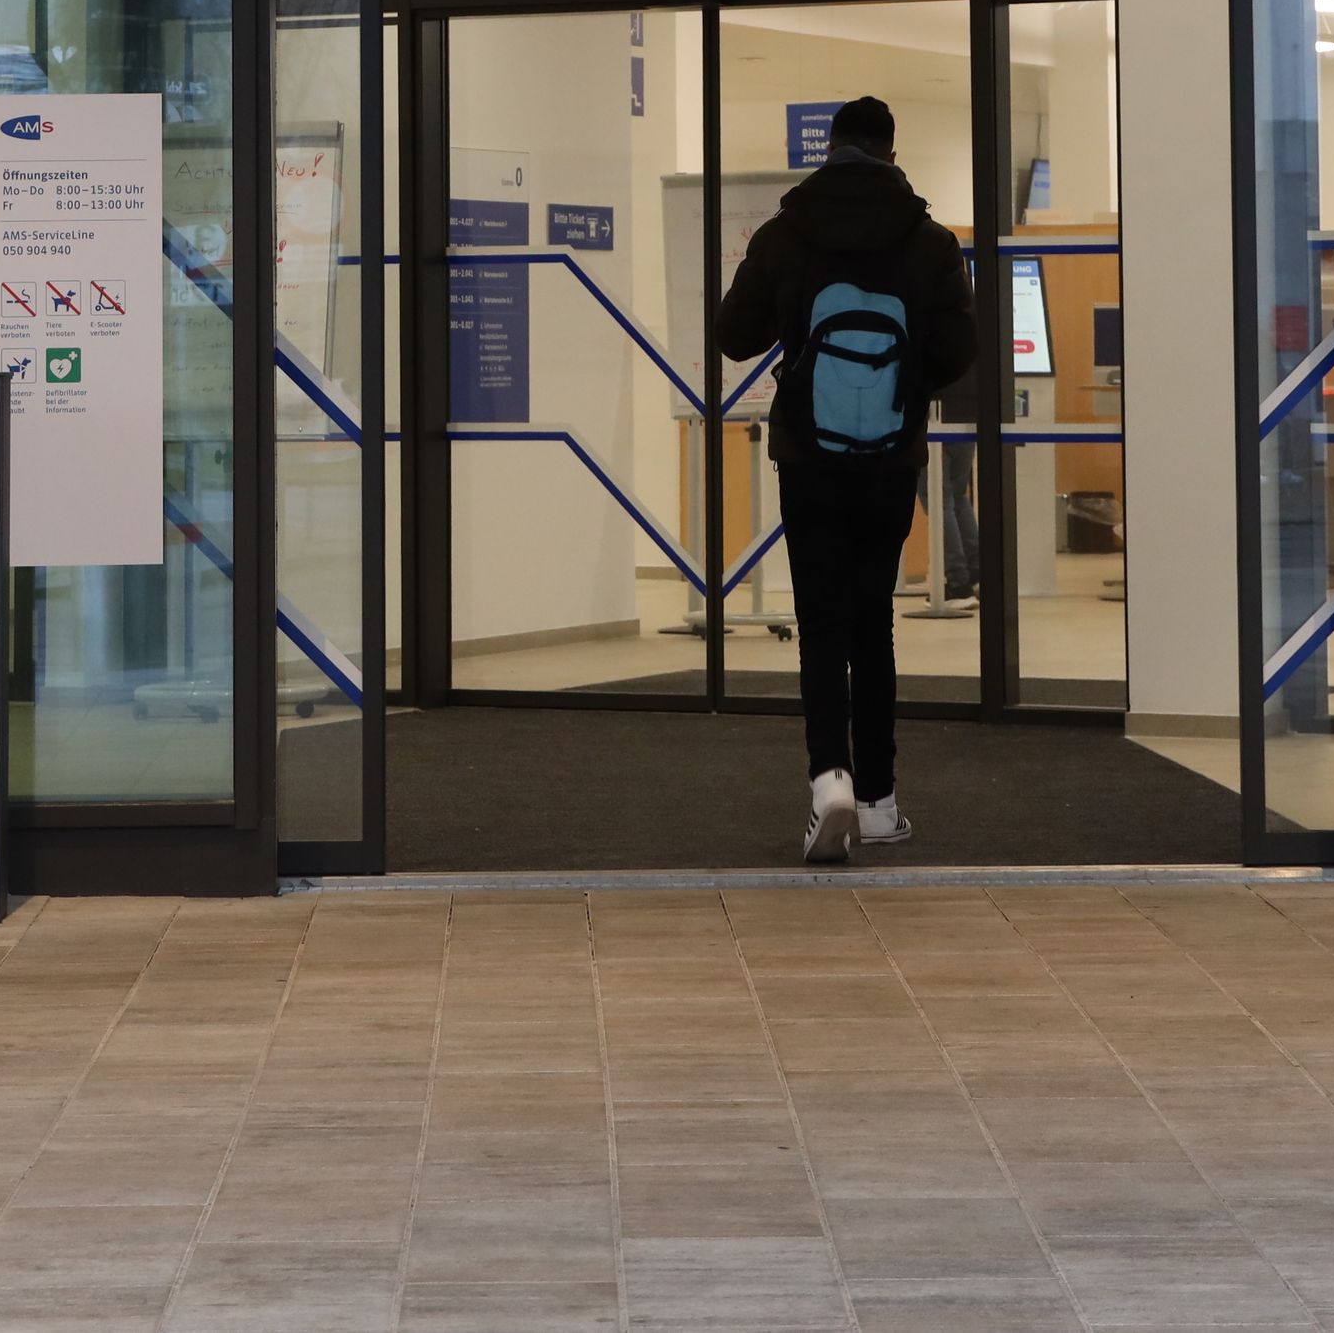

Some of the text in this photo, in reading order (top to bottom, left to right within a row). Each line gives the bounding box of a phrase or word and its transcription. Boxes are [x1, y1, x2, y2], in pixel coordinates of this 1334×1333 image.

[13, 121, 54, 133] AMS
[801, 128, 825, 138] Bitte
[802, 153, 828, 163] ziehe
[2, 168, 88, 182] Öffnungszeiten
[125, 184, 145, 195] Uhr
[2, 200, 13, 211] Fr
[125, 199, 145, 210] Uhr
[2, 230, 95, 241] AMS-ServiceLine
[2, 245, 71, 256] 050 904 940
